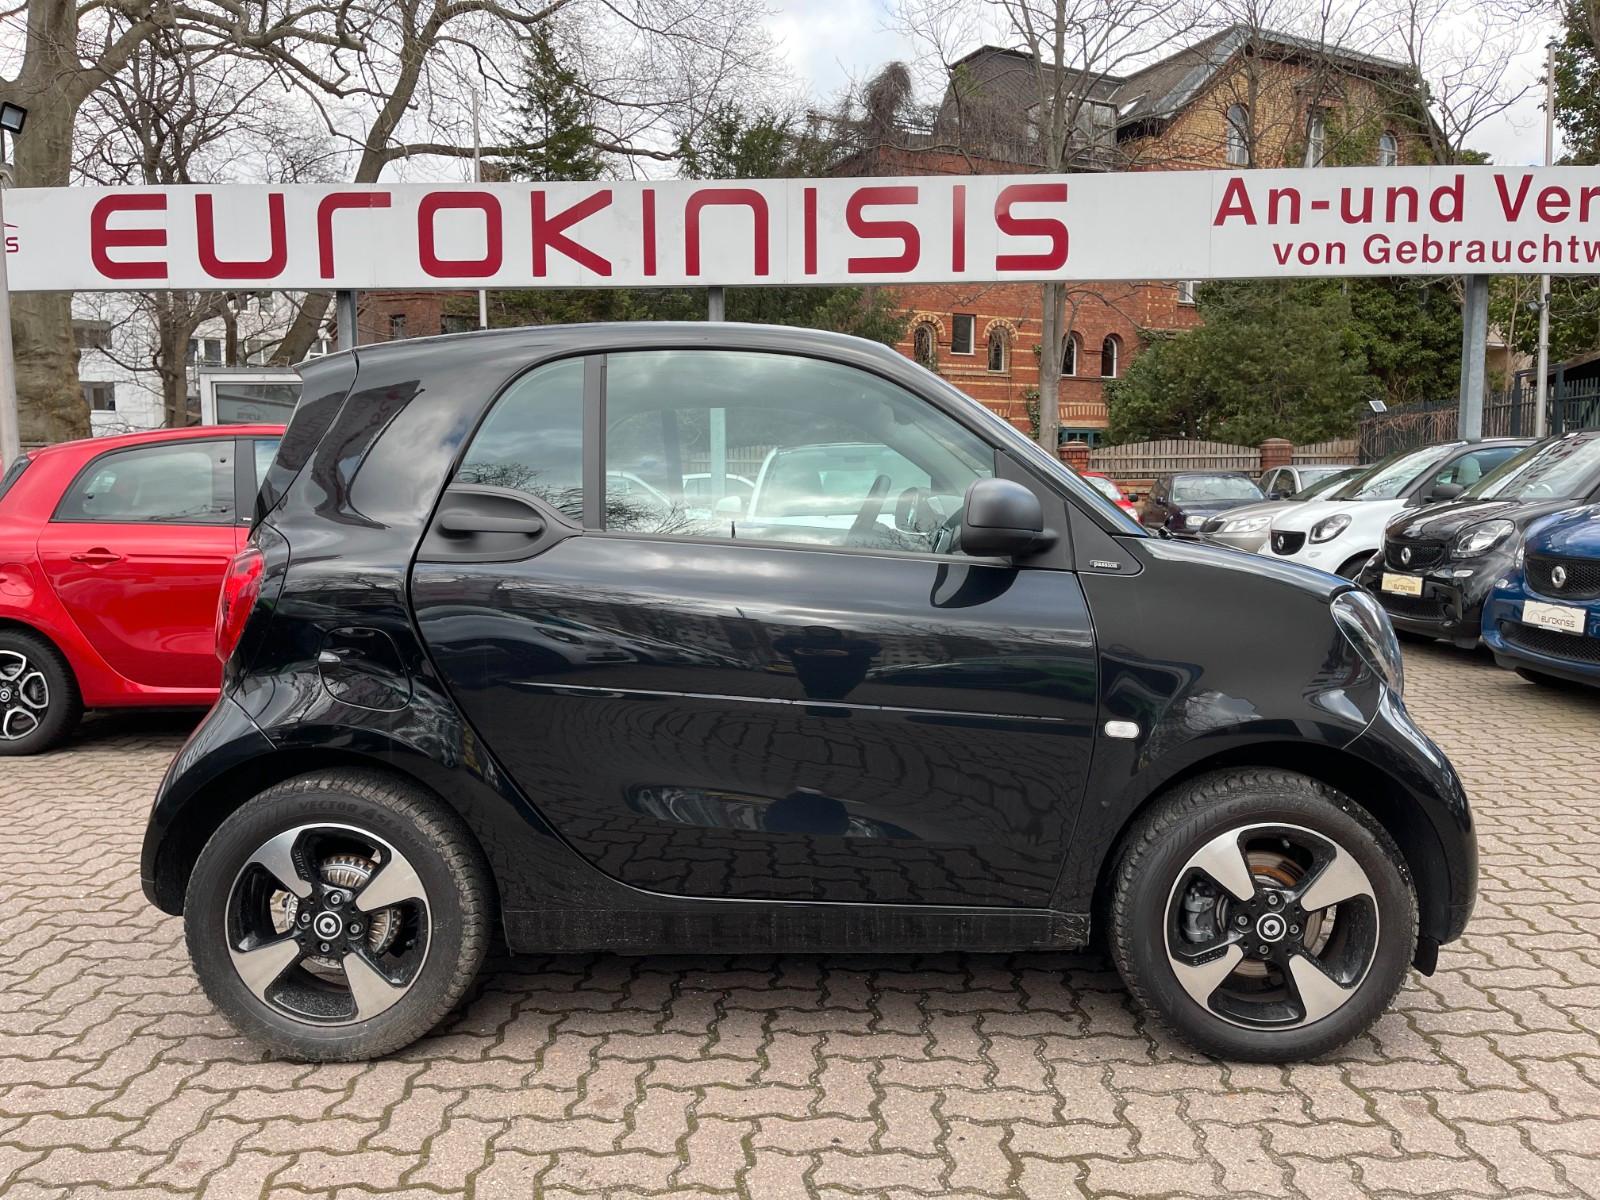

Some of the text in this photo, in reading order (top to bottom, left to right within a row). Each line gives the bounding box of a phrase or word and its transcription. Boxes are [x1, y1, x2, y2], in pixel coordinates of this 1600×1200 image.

[1214, 174, 1600, 226] An-und Ver
[90, 183, 1070, 280] EUROKINISIS
[1273, 242, 1346, 266] von
